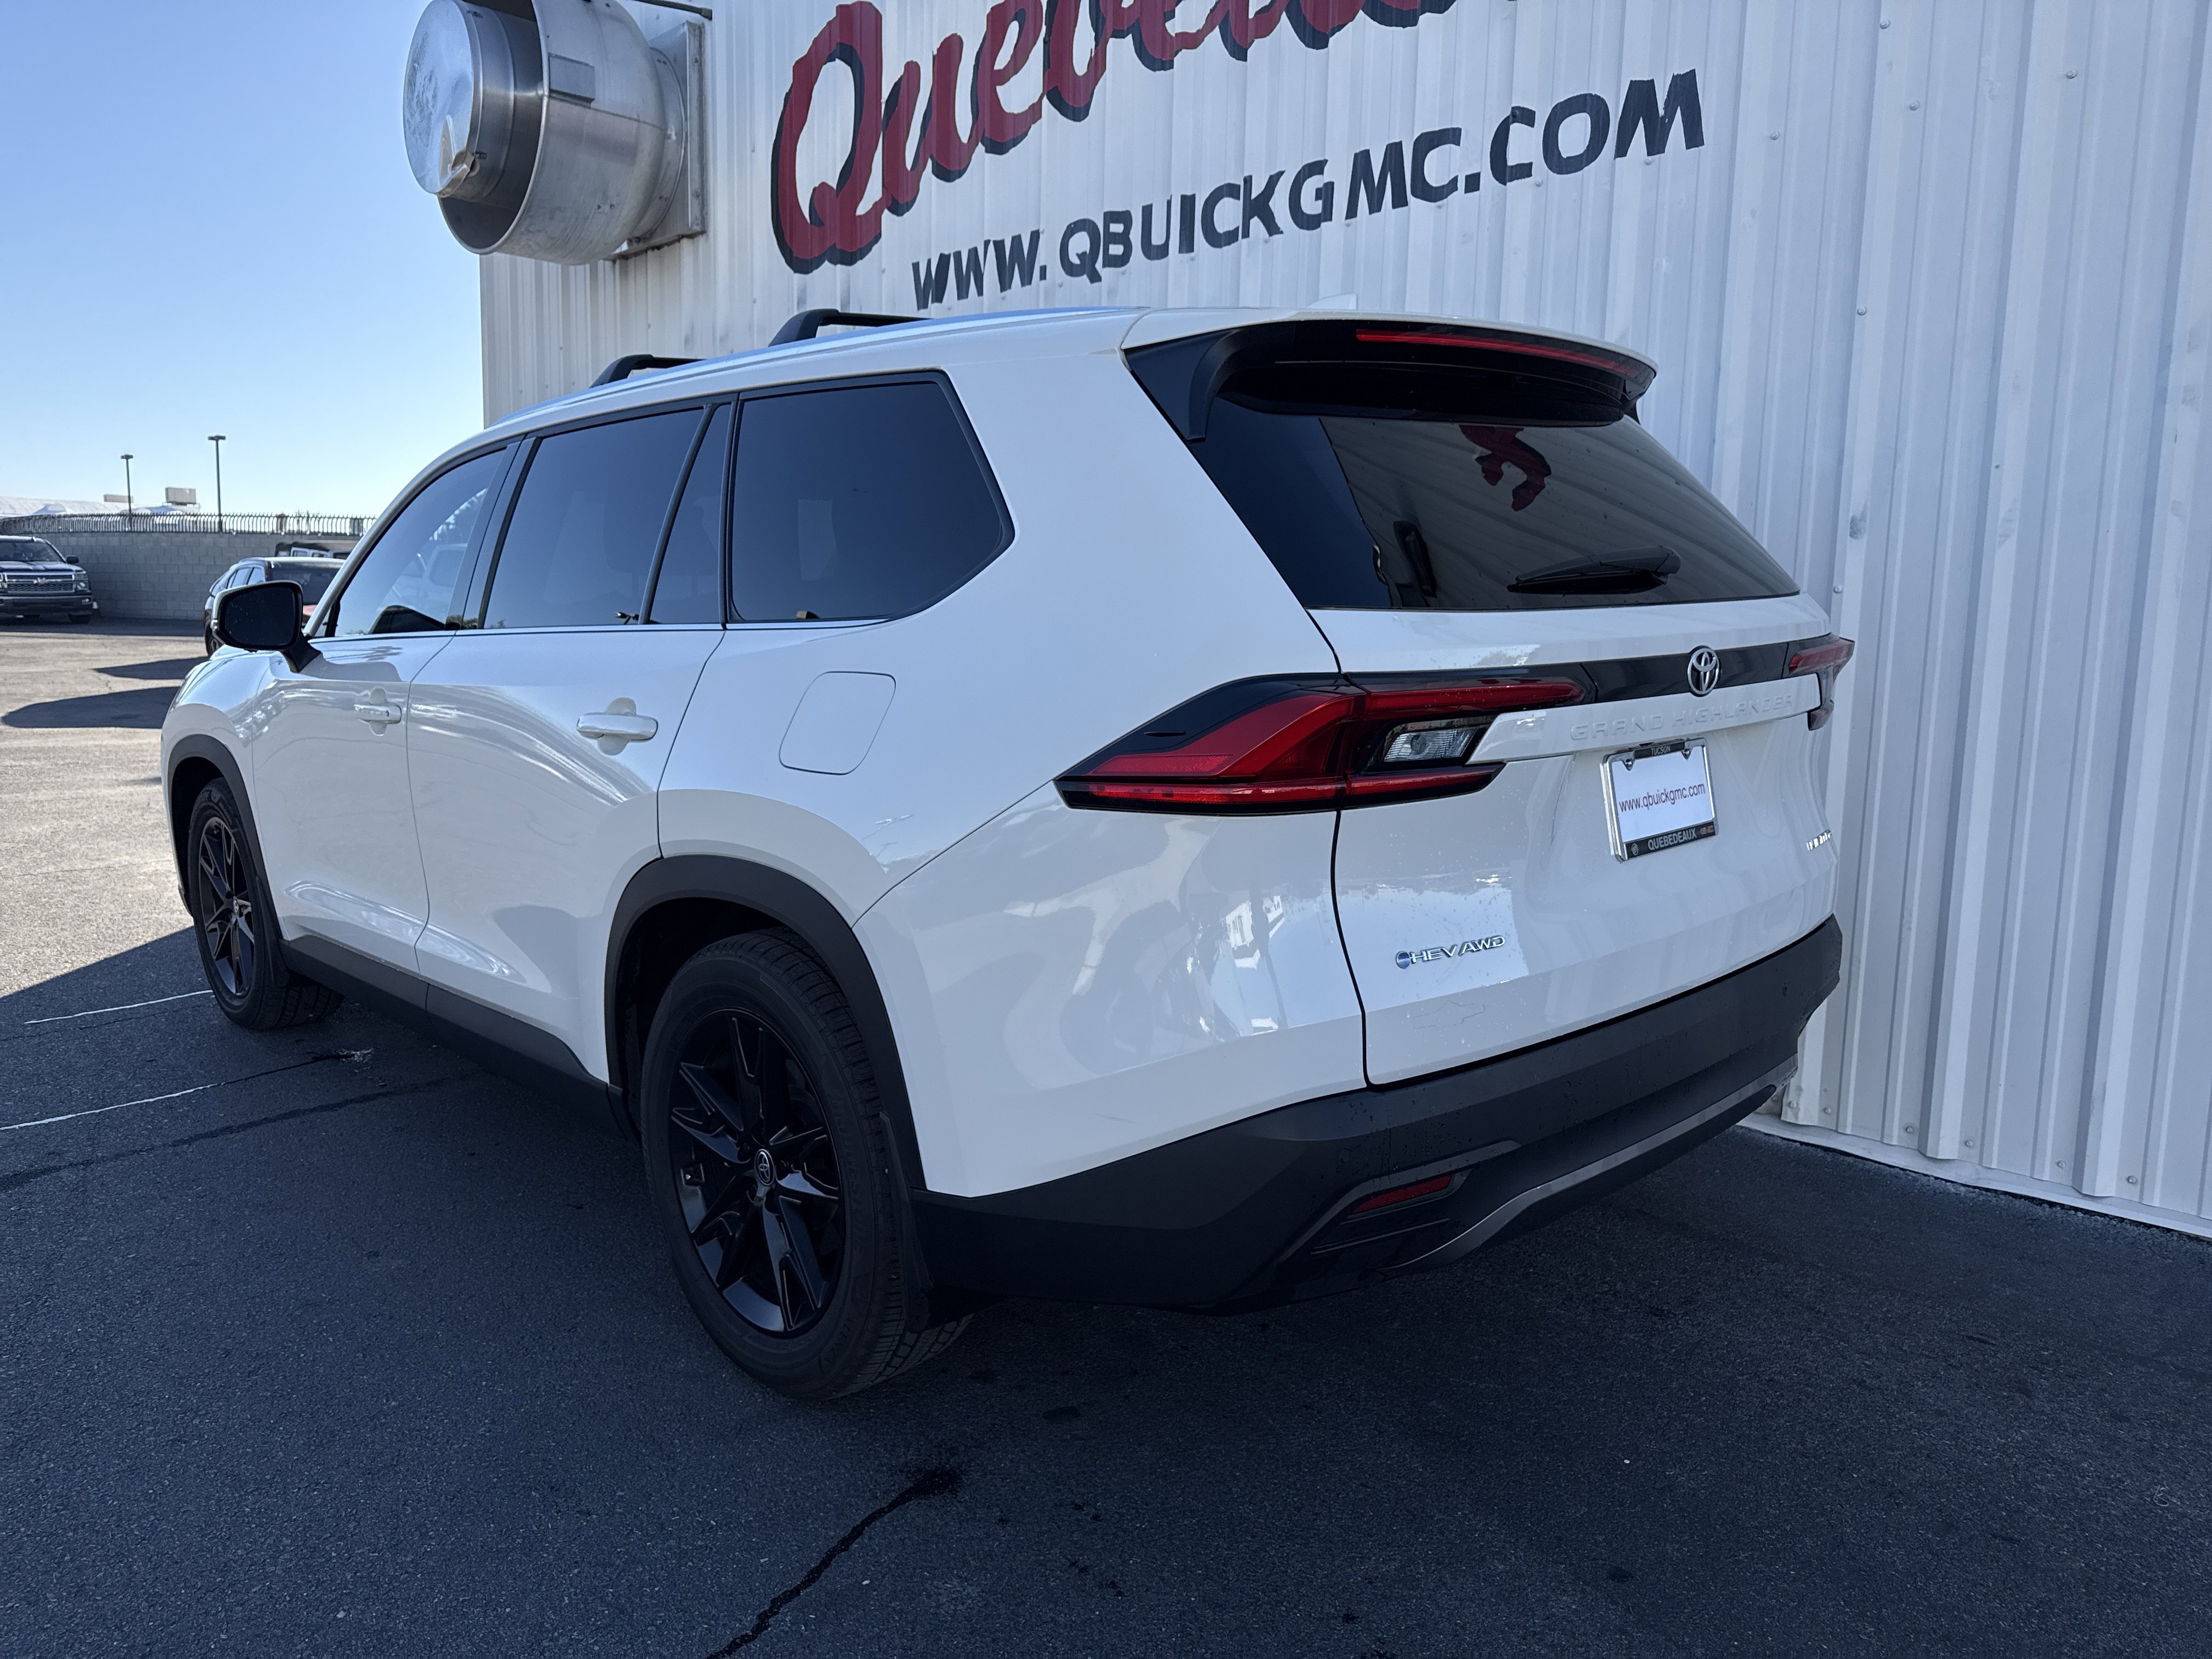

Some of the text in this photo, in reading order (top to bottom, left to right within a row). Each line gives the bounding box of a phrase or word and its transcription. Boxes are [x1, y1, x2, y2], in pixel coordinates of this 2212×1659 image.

[1570, 693, 1793, 741] GRAND HIGHLANDER
[1651, 745, 1671, 756] TUCSON
[1618, 783, 1706, 813] www.qbuickgmc.com
[1647, 827, 1697, 851] QUEBEDEAUX
